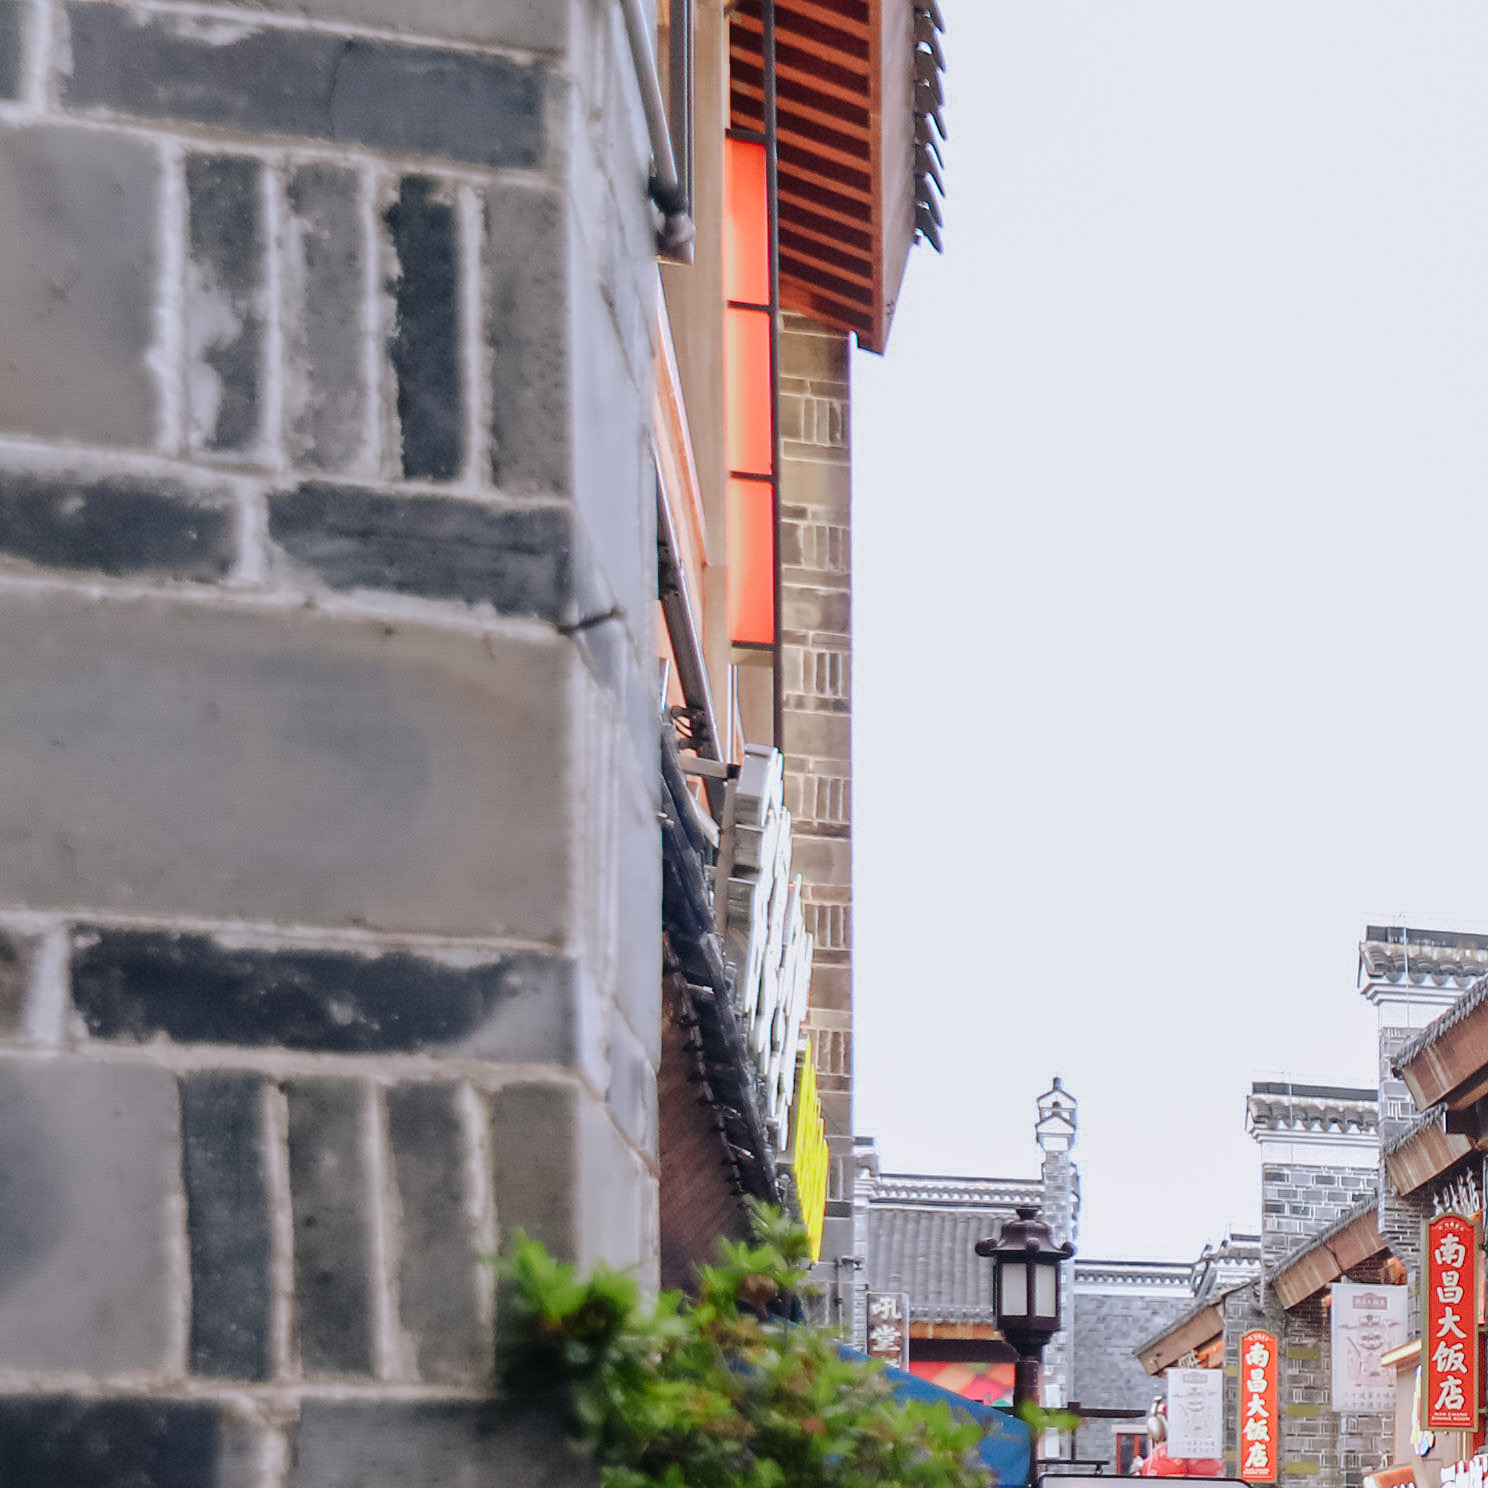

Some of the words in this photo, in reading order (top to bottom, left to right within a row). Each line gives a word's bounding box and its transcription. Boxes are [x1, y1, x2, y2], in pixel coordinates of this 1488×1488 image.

[1432, 1233, 1468, 1411] 南昌大饭店
[1243, 1341, 1271, 1468] 南昌大饭店
